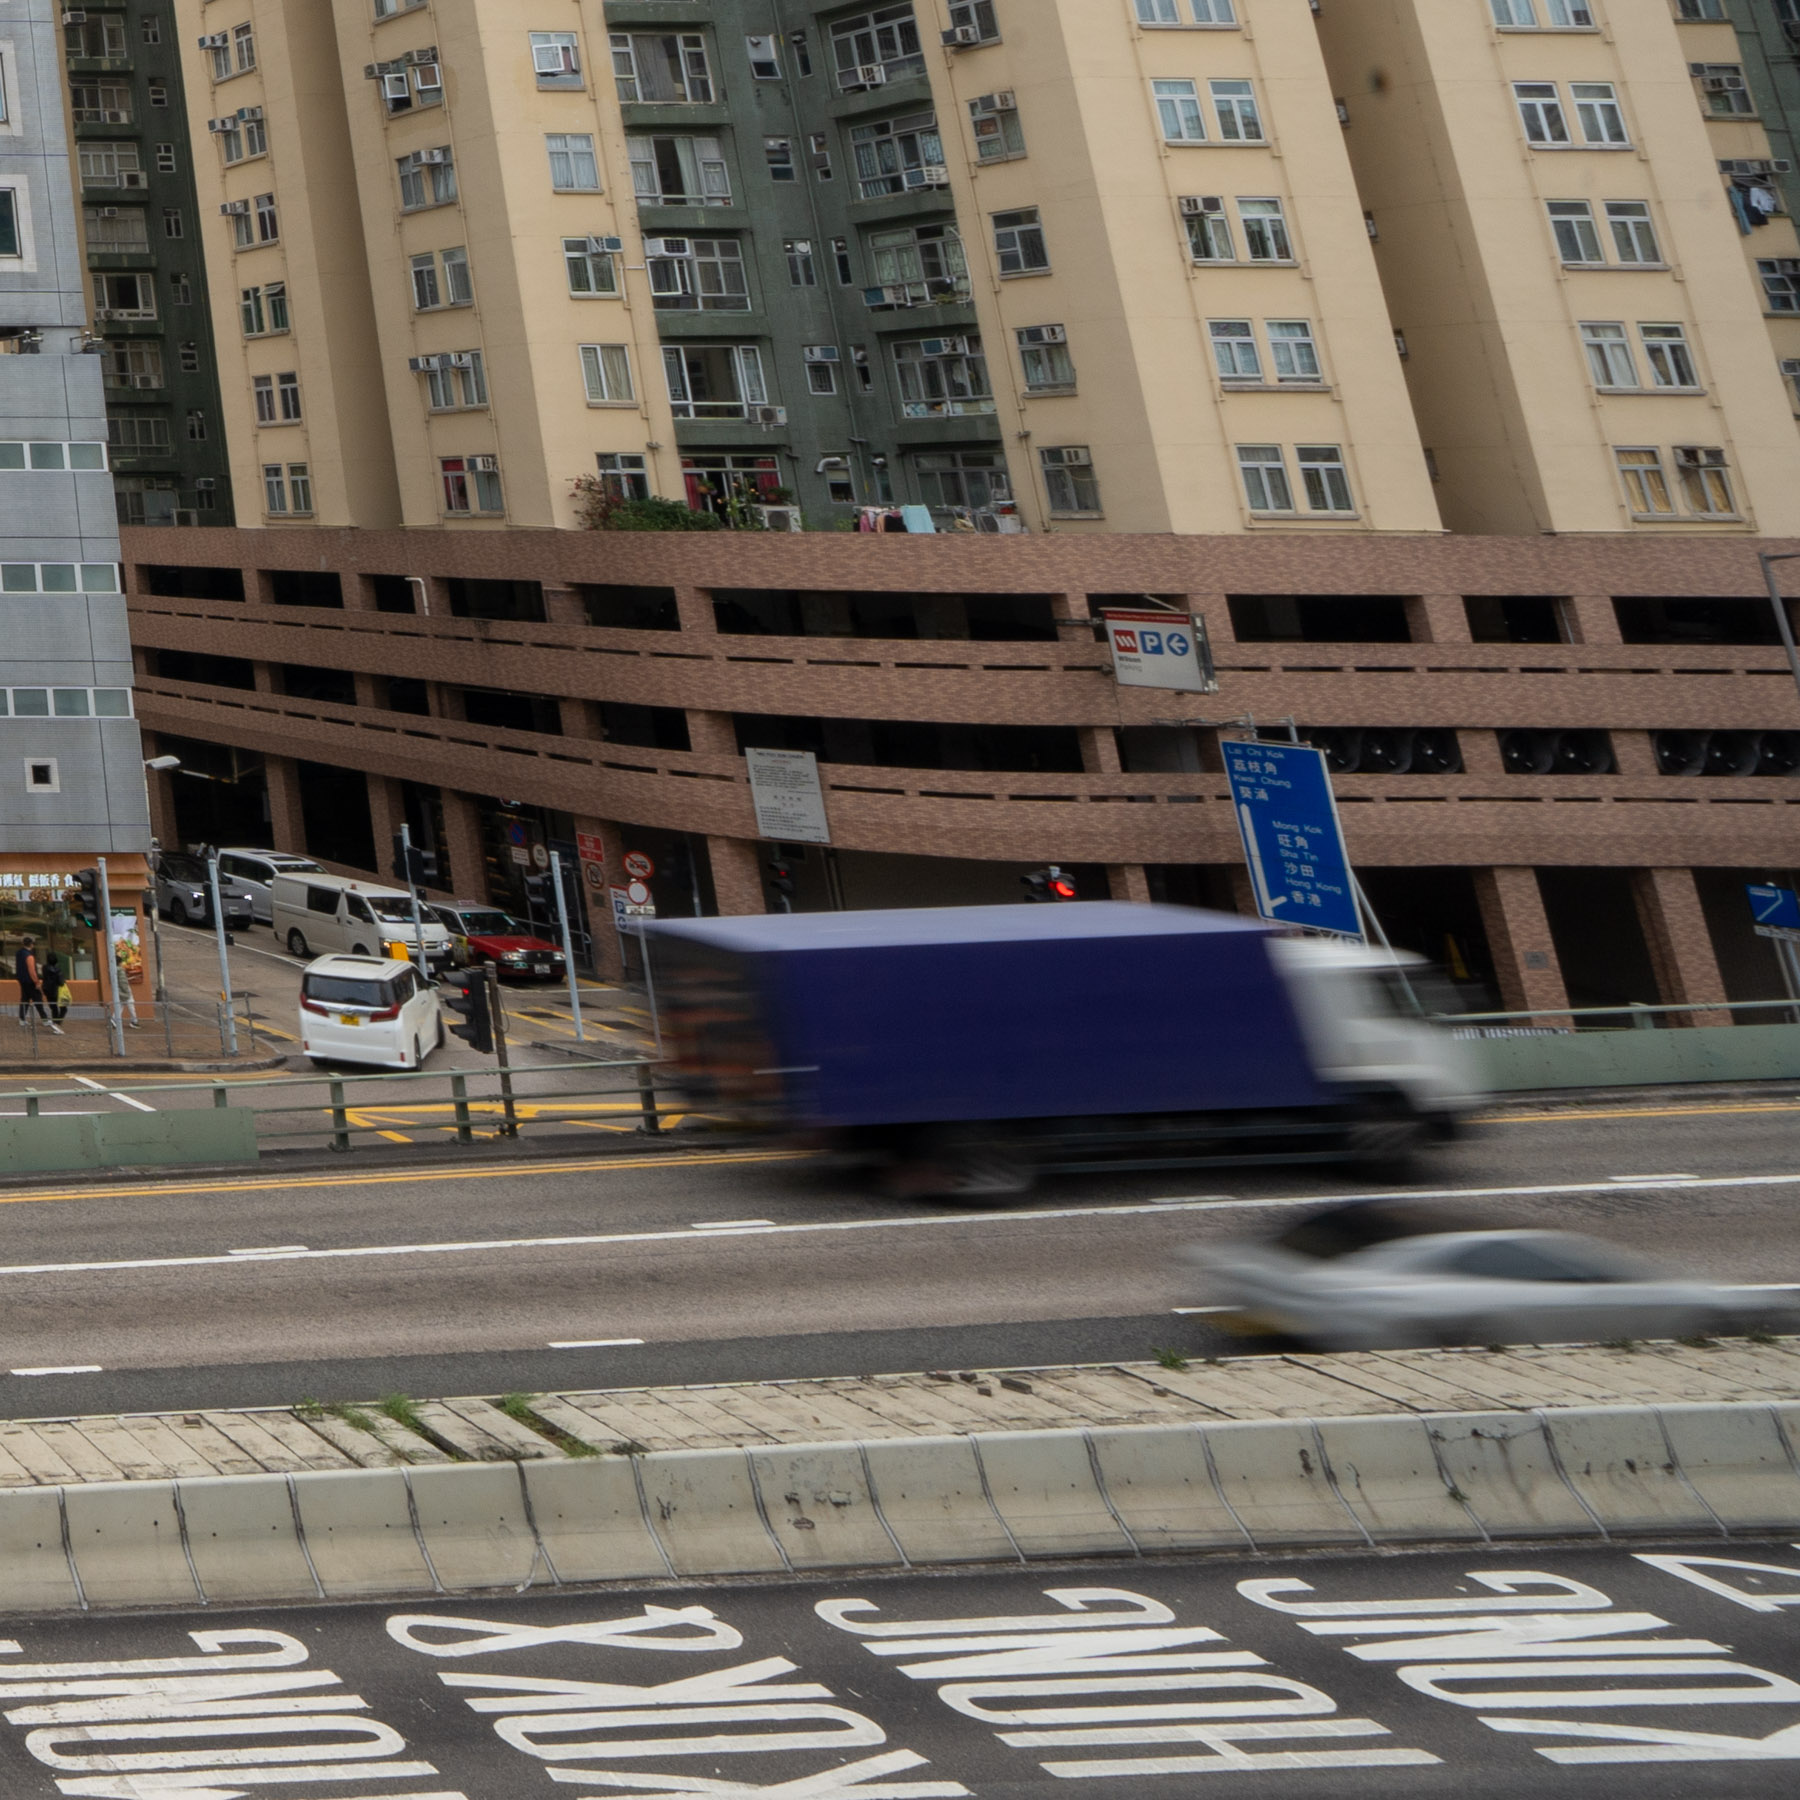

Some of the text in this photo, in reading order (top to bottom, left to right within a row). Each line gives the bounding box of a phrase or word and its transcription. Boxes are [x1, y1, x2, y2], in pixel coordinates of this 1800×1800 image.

[1228, 746, 1285, 759] Lai Chi Kok
[1233, 758, 1277, 775] 荔枝角
[1233, 774, 1292, 788] Kwai Chung
[1272, 820, 1323, 835] Mong Kok
[1277, 834, 1309, 849] 旺角
[1280, 849, 1319, 861] Sha Tin
[1284, 862, 1315, 877] 沙田
[1286, 878, 1342, 894] Hong Kong
[1292, 891, 1322, 907] 香港
[814, 1586, 1446, 1778] HONG
